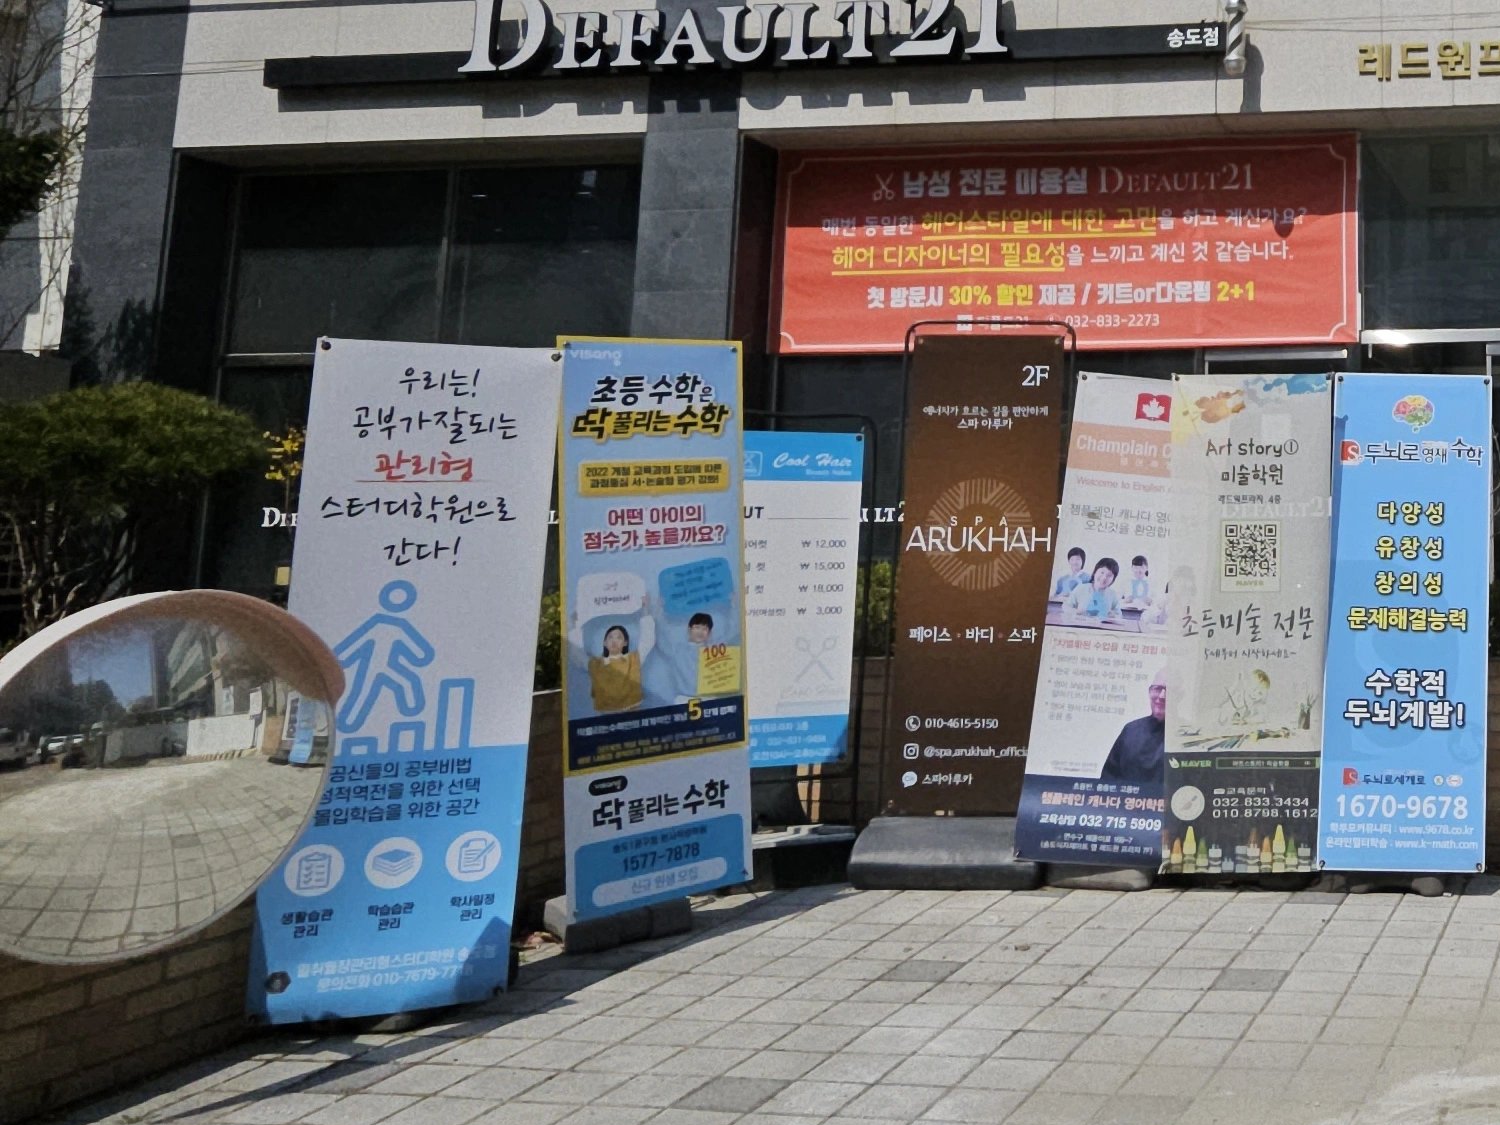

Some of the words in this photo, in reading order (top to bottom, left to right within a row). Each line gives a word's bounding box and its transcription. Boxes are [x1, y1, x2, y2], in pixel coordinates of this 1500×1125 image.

[1167, 27, 1219, 48] 송도점
[903, 169, 951, 198] 남성
[959, 168, 1007, 196] 전문
[1015, 167, 1088, 195] 미용실
[1099, 163, 1254, 193] DEFAULT21
[864, 216, 915, 237] 동일한
[921, 209, 1052, 233] 헤어스타일에
[1061, 208, 1105, 232] 대한
[1113, 205, 1174, 231] 고민을
[1183, 207, 1218, 227] 하고
[832, 245, 875, 269] 헤어
[883, 243, 990, 268] 디자이너의
[1000, 241, 1084, 267] 필요성을
[1091, 244, 1145, 264] 느끼고
[1151, 242, 1185, 263] 계신
[1192, 242, 1209, 263] 것
[867, 287, 884, 308] 첫
[890, 286, 943, 308] 방문시
[948, 285, 992, 306] 30%
[996, 285, 1034, 306] 할인
[1038, 284, 1076, 305] 제공
[1217, 281, 1255, 302] 2+1
[1064, 314, 1160, 328] 032-833-2273
[399, 367, 481, 398] 우리는!
[1021, 365, 1050, 387] 2F
[591, 374, 646, 406] 초등
[648, 372, 713, 405] 수학은
[612, 410, 673, 435] 풀리는
[673, 403, 730, 435] 수학
[957, 418, 979, 429] 스파
[982, 418, 1013, 430] 아루카
[1076, 434, 1158, 458] Champlain
[1205, 438, 1233, 457] Art
[374, 450, 473, 481] 관리형
[773, 452, 810, 468] Cool
[1221, 463, 1284, 486] 미술학원
[607, 508, 645, 527] 어떤
[649, 504, 703, 525] 아이의
[1376, 501, 1445, 525] 다양성
[584, 529, 640, 551] 점수가
[644, 524, 726, 547] 높을까요?
[815, 539, 847, 548] 12,000
[905, 525, 1052, 553] ARUKHAH
[1375, 536, 1444, 560] 유창성
[383, 536, 462, 566] 간다!
[814, 562, 845, 570] 15,000
[1374, 571, 1443, 595] 창의성
[816, 607, 843, 615] 3,000
[1182, 603, 1262, 643] 초등미술
[1273, 605, 1315, 640] 전문
[1347, 607, 1469, 631] 문제해결능력
[908, 626, 953, 643] 페이스
[965, 626, 994, 643] 바디
[1007, 626, 1038, 643] 스파
[1365, 668, 1446, 697] 수학적
[925, 718, 999, 729] 010-4615-5150
[1343, 699, 1466, 729] 두뇌계발!
[330, 761, 400, 783] 공신들의
[404, 757, 473, 778] 공부비법
[1180, 760, 1212, 768] NAVER
[409, 780, 444, 798] 위한
[447, 777, 482, 796] 선택
[407, 801, 443, 819] 위한
[445, 798, 481, 817] 공간
[627, 793, 680, 824] 풀리는
[683, 779, 730, 815] 수학
[1088, 795, 1121, 809] 캐나다
[1336, 794, 1468, 820] 1670-9678
[1079, 815, 1102, 827] 032
[1105, 817, 1127, 828] 715
[1130, 818, 1162, 831] 5909
[1399, 824, 1475, 836] www.9678.co.kr
[622, 842, 700, 873] 1577-7878
[377, 918, 401, 932] 관리
[460, 908, 483, 922] 관리
[293, 924, 319, 939] 관리
